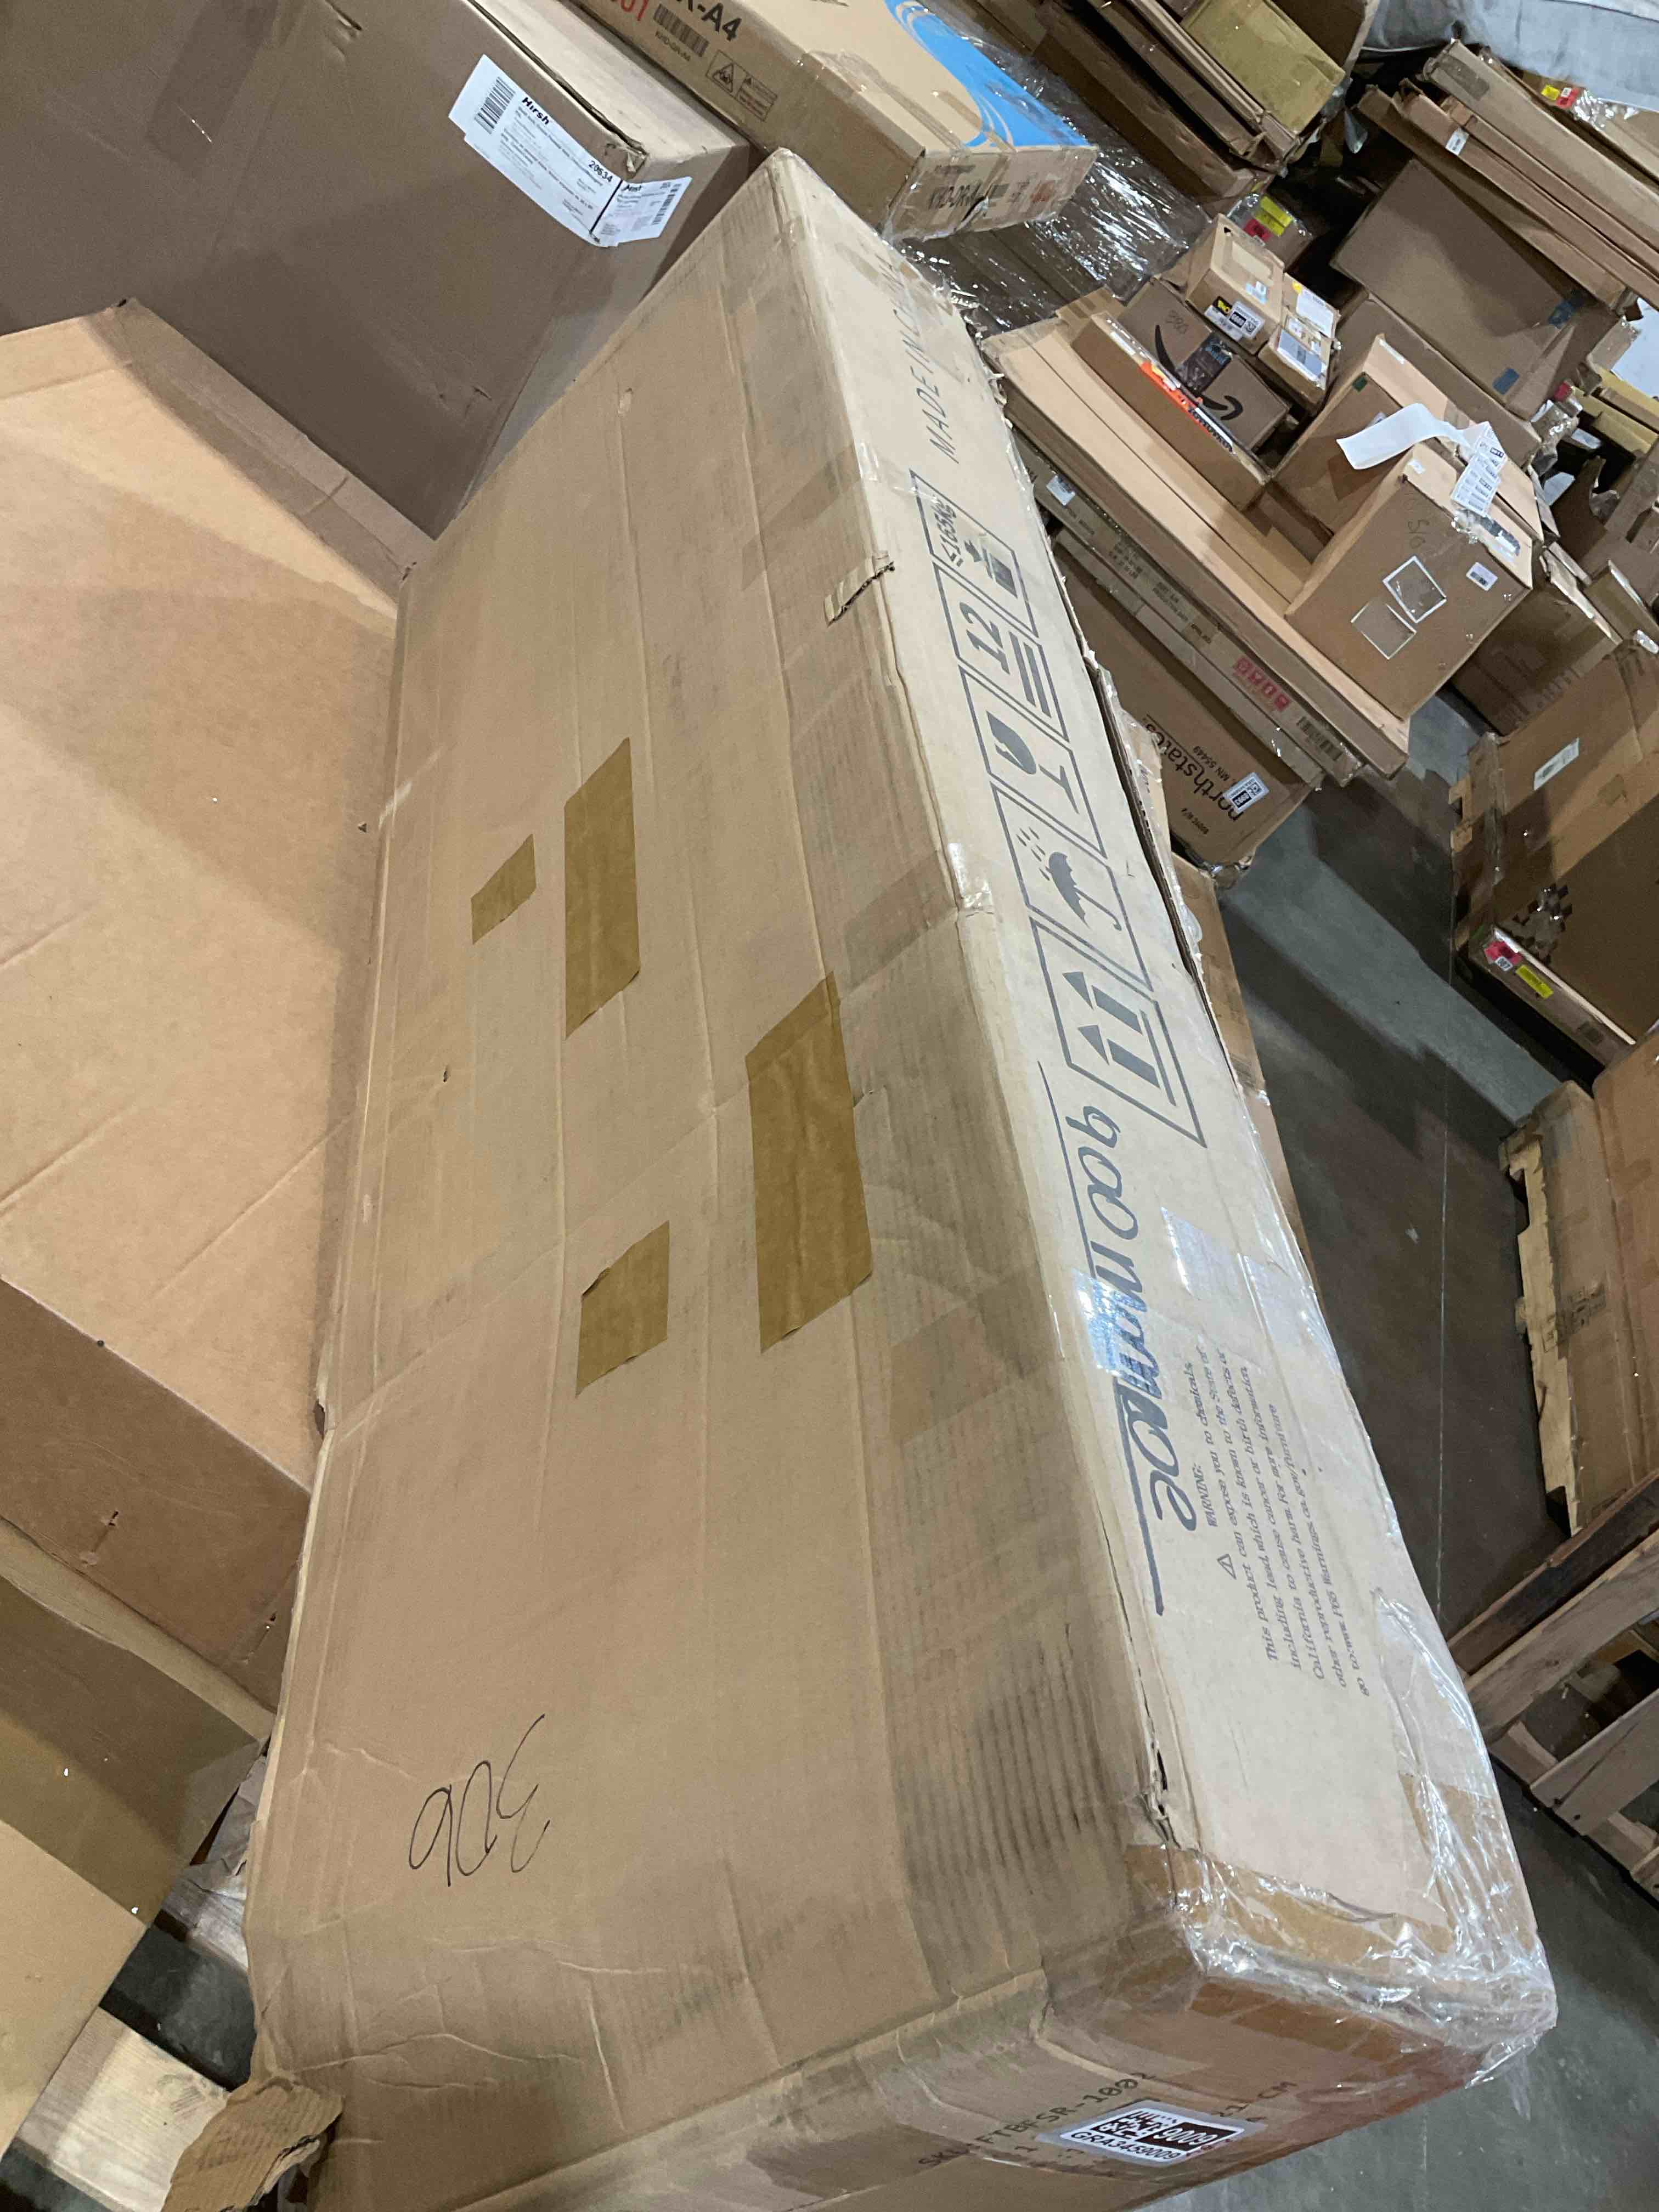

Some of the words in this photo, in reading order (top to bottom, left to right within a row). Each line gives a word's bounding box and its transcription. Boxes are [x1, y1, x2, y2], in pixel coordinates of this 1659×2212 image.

[677, 0, 742, 42] -A4
[522, 97, 550, 125] Hirsh
[899, 330, 934, 374] IN
[910, 365, 960, 464] MADE
[960, 601, 1011, 675] 12
[1216, 1347, 1227, 1365] or
[1223, 1367, 1242, 1415] defects
[1215, 1404, 1227, 1426] the
[1204, 1430, 1214, 1445] to
[1223, 1430, 1233, 1444] to
[1235, 1418, 1255, 1455] birth
[1210, 1451, 1225, 1476] you
[1228, 1449, 1246, 1488] known
[1250, 1458, 1261, 1475] or
[1265, 1446, 1281, 1479] more
[1192, 1462, 1218, 1527] WARNING:
[1218, 1479, 1238, 1526] expose
[1242, 1492, 1252, 1509] is
[1256, 1477, 1276, 1525] cancer
[1234, 1531, 1247, 1558] can
[1272, 1528, 1290, 1571] cause
[1243, 1563, 1268, 1622] product
[1286, 1573, 1296, 1590] to
[1297, 1547, 1334, 1644] reproductive
[1262, 1626, 1279, 1661] This
[1273, 1594, 1302, 1671] including
[1294, 1596, 1324, 1680] California
[1329, 1644, 1347, 1688] other
[1357, 1677, 1370, 1697] go
[1070, 2131, 1181, 2160] GRA3459009
[1154, 2127, 1220, 2146] 9009
